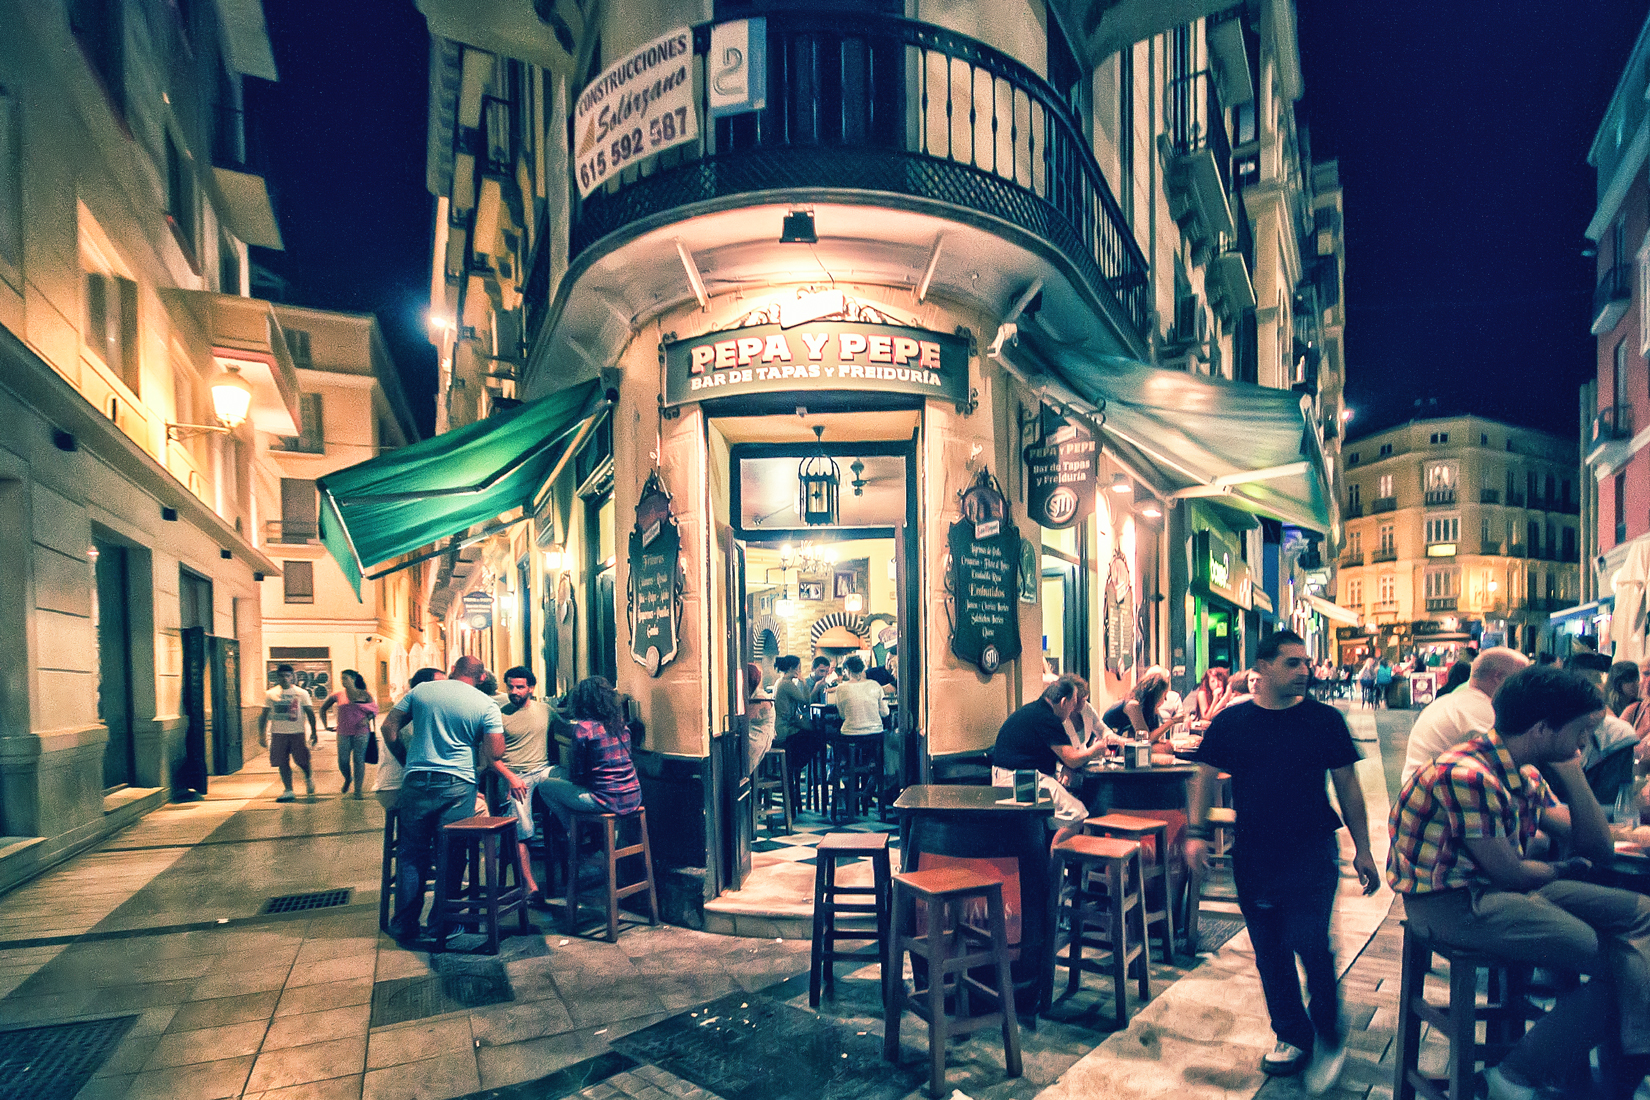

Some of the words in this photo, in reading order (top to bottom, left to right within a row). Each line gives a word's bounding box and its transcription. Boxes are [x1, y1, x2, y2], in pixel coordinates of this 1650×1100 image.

[578, 33, 687, 117] CONSTRUCCIONES
[580, 149, 607, 190] 615
[611, 128, 643, 165] 592
[649, 106, 688, 146] 587
[690, 334, 793, 374] PEPA
[802, 333, 829, 362] Y
[838, 333, 941, 370] PEPE
[691, 370, 726, 391] BAR
[729, 369, 753, 384] DE
[757, 364, 821, 381] TAPAS
[838, 365, 941, 387] FREIDURÍA
[1066, 441, 1096, 455] PEPE
[1033, 465, 1048, 474] Bar
[1049, 462, 1061, 472] de
[1062, 459, 1091, 472] Tapas
